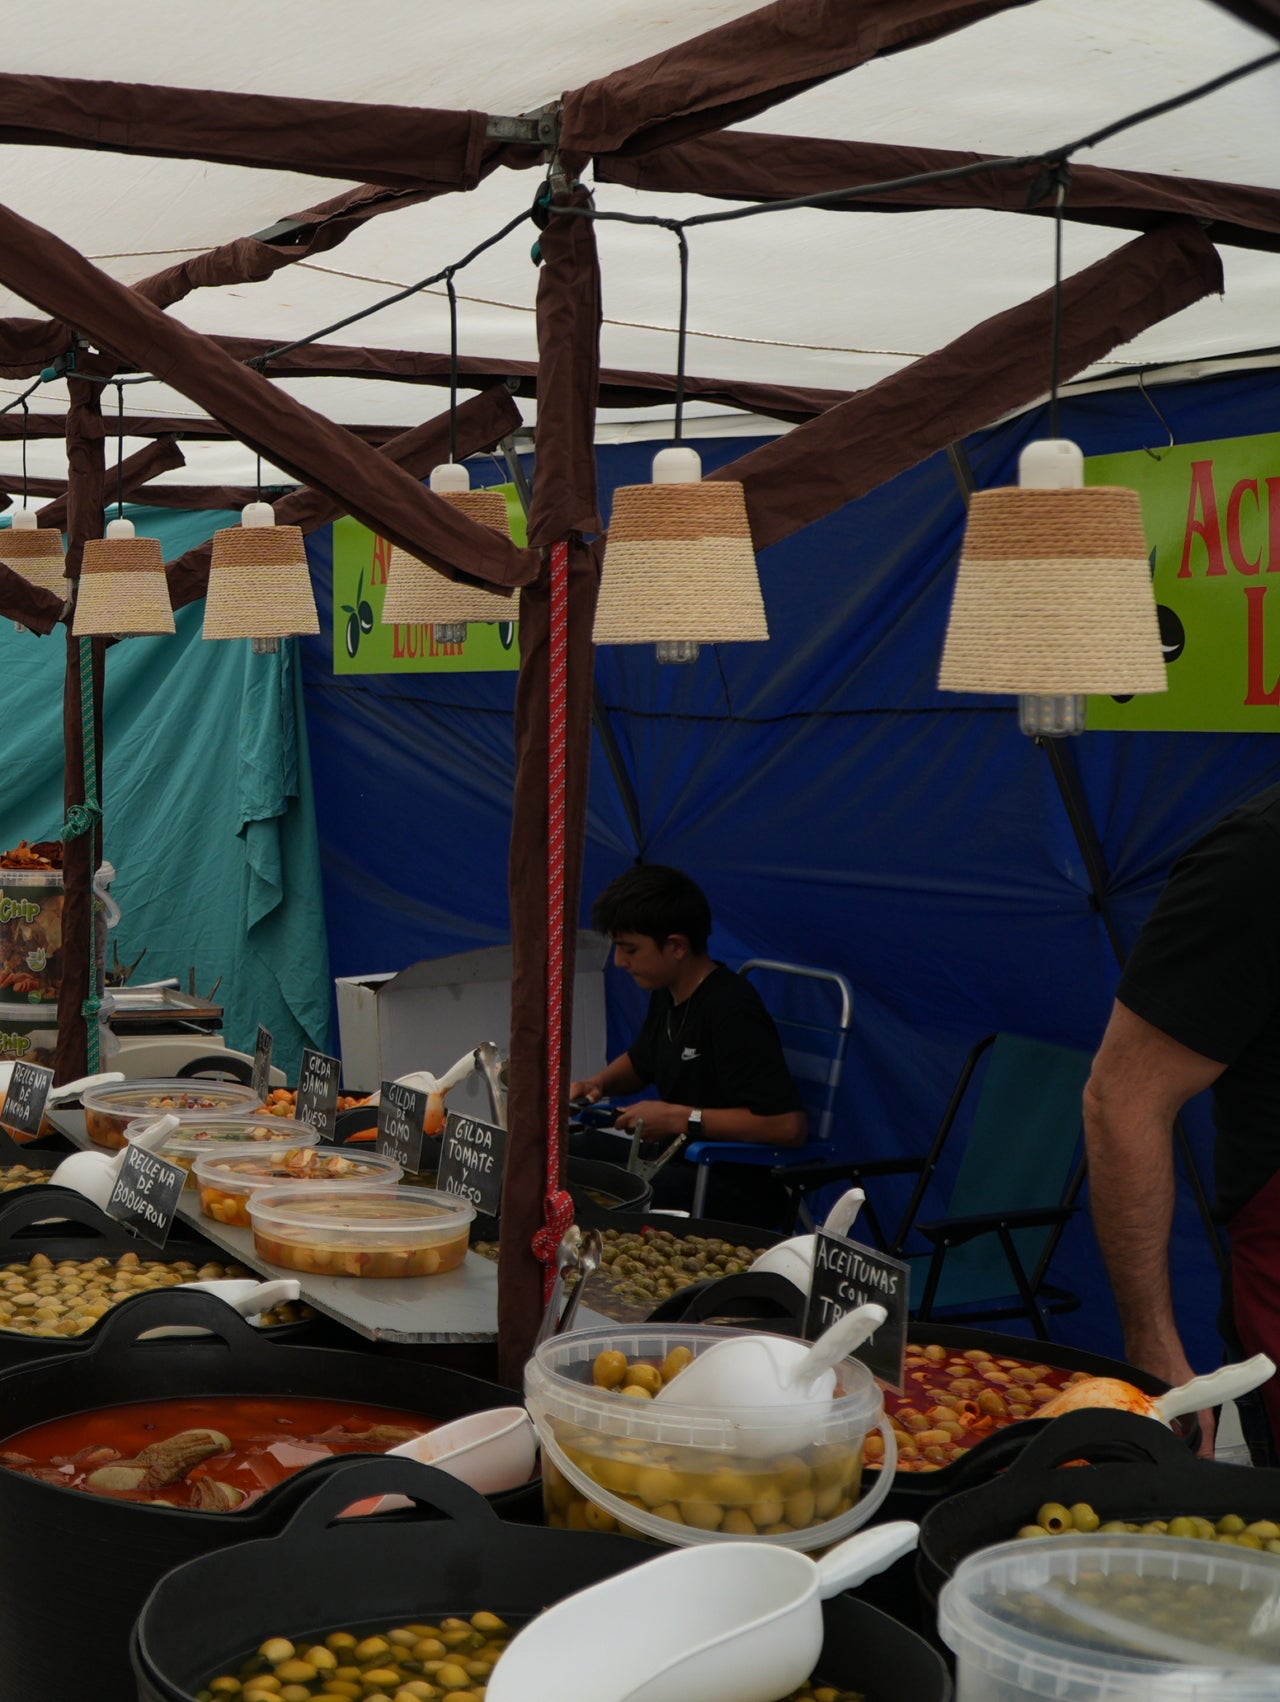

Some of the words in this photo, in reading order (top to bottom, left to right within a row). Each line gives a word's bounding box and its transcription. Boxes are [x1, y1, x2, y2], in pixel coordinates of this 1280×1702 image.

[309, 1056, 331, 1078] GILDA
[20, 1086, 32, 1102] DE
[302, 1071, 329, 1099] JAMON
[388, 1085, 417, 1113] GILDA
[301, 1104, 327, 1128] QUESO
[384, 1115, 410, 1142] LOMO
[455, 1119, 493, 1150] GILDA
[382, 1141, 408, 1165] QUESO
[449, 1139, 495, 1174] TOMATE
[128, 1147, 176, 1188] RELLENA
[136, 1175, 154, 1195] DE
[445, 1175, 482, 1204] QUESO
[112, 1179, 167, 1229] BOQUERON
[816, 1237, 899, 1295] ACEITUNAS
[838, 1280, 868, 1307] CON
